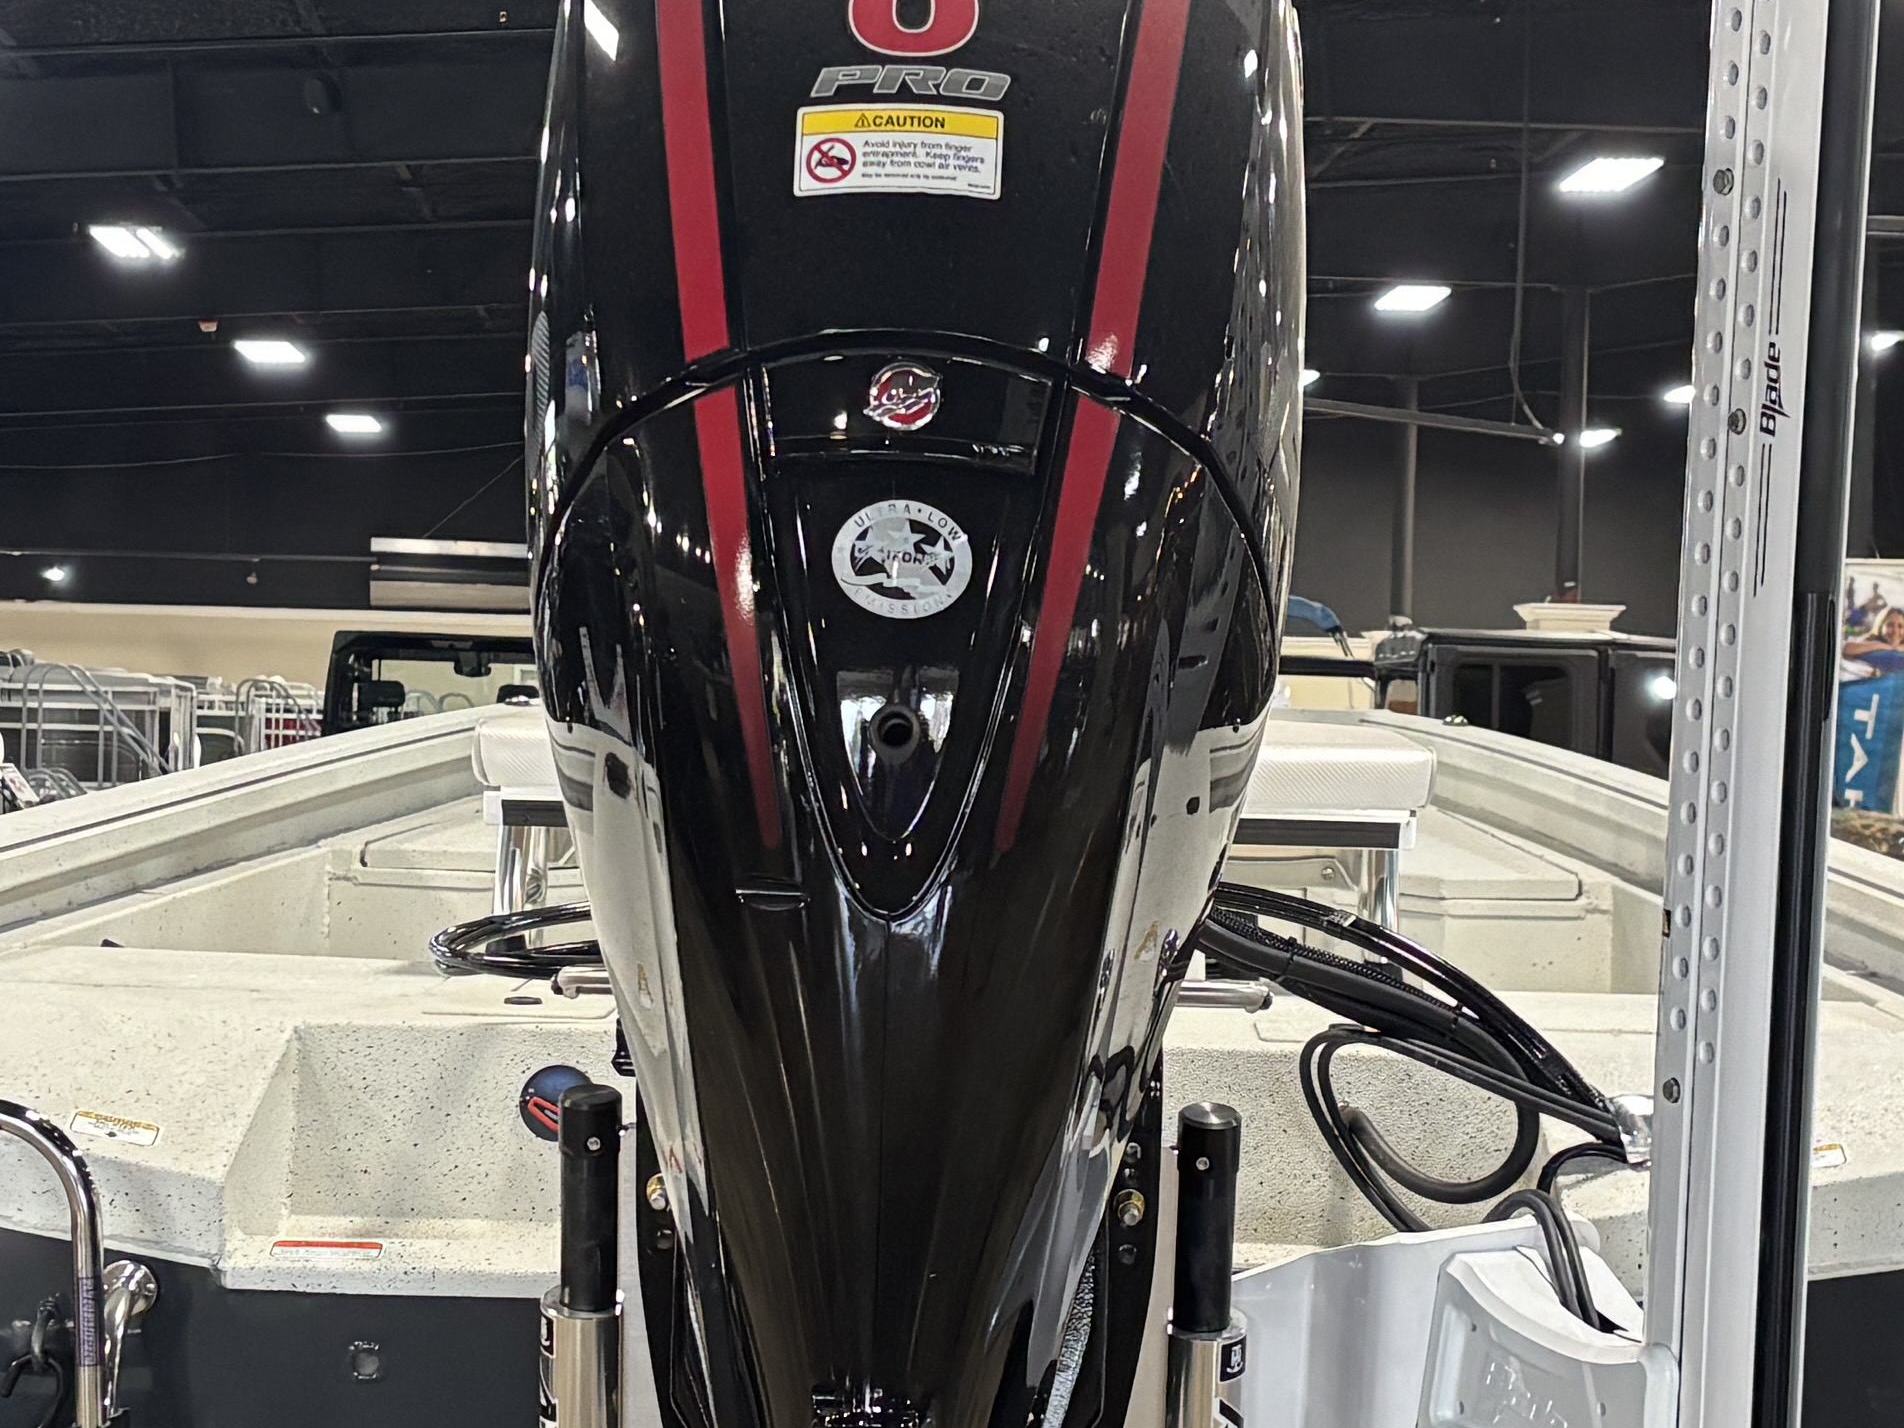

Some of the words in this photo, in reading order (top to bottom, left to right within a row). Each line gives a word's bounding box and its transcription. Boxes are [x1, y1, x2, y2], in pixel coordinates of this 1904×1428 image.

[811, 64, 1012, 100] PRO
[873, 115, 946, 129] CAUTION
[862, 139, 890, 150] Avoid
[892, 140, 918, 152] injury
[920, 141, 943, 150] from
[944, 142, 973, 154] finger
[890, 158, 912, 168] from
[925, 150, 951, 163] Keep
[1759, 341, 1791, 437] Blade
[928, 510, 962, 542] LOW
